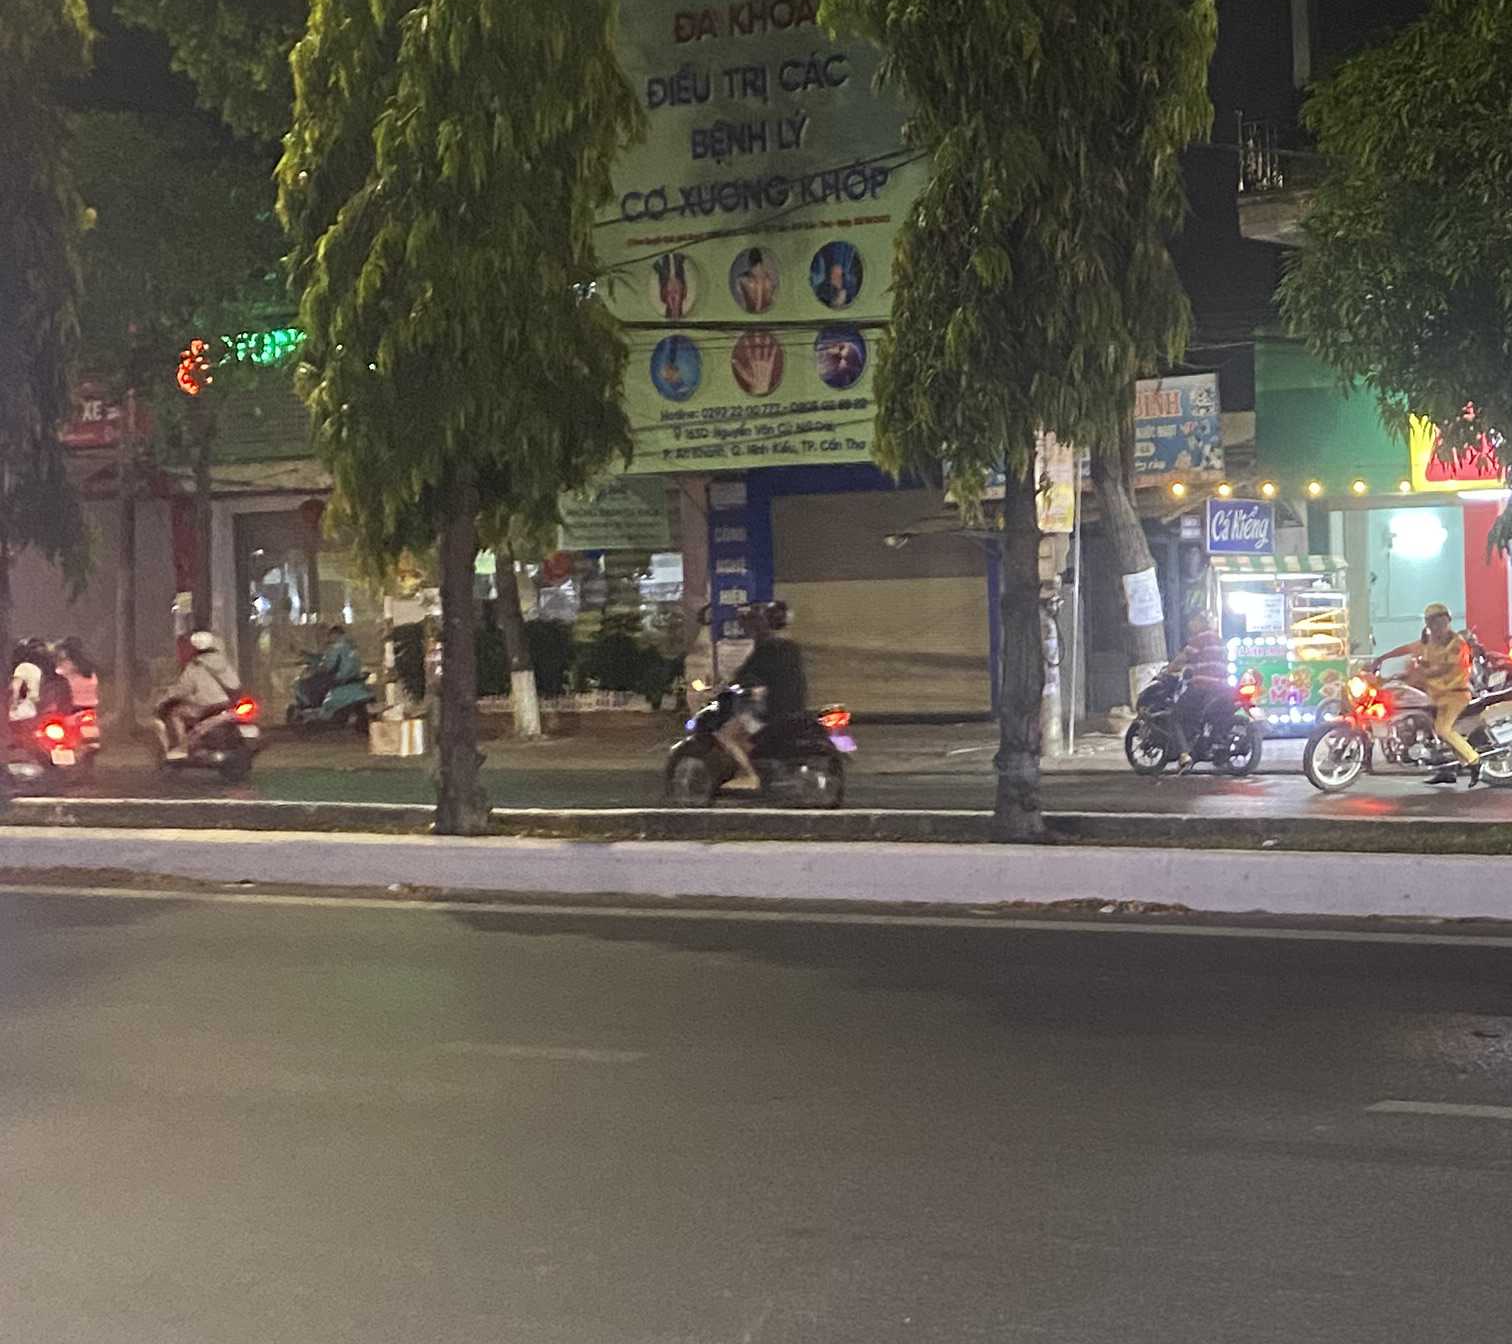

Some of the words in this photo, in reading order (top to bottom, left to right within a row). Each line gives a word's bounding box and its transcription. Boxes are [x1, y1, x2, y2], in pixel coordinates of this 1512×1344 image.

[673, 10, 717, 43] ĐA
[647, 63, 711, 109] ĐIỀU
[722, 64, 769, 104] TRỊ
[779, 51, 849, 92] CÁC
[691, 119, 767, 164] BỆNH
[778, 110, 809, 150] LÝ
[621, 185, 668, 222] CƠ
[679, 175, 790, 217] XƯƠNG
[800, 159, 890, 203] KHỚP
[1212, 509, 1230, 542] Cá
